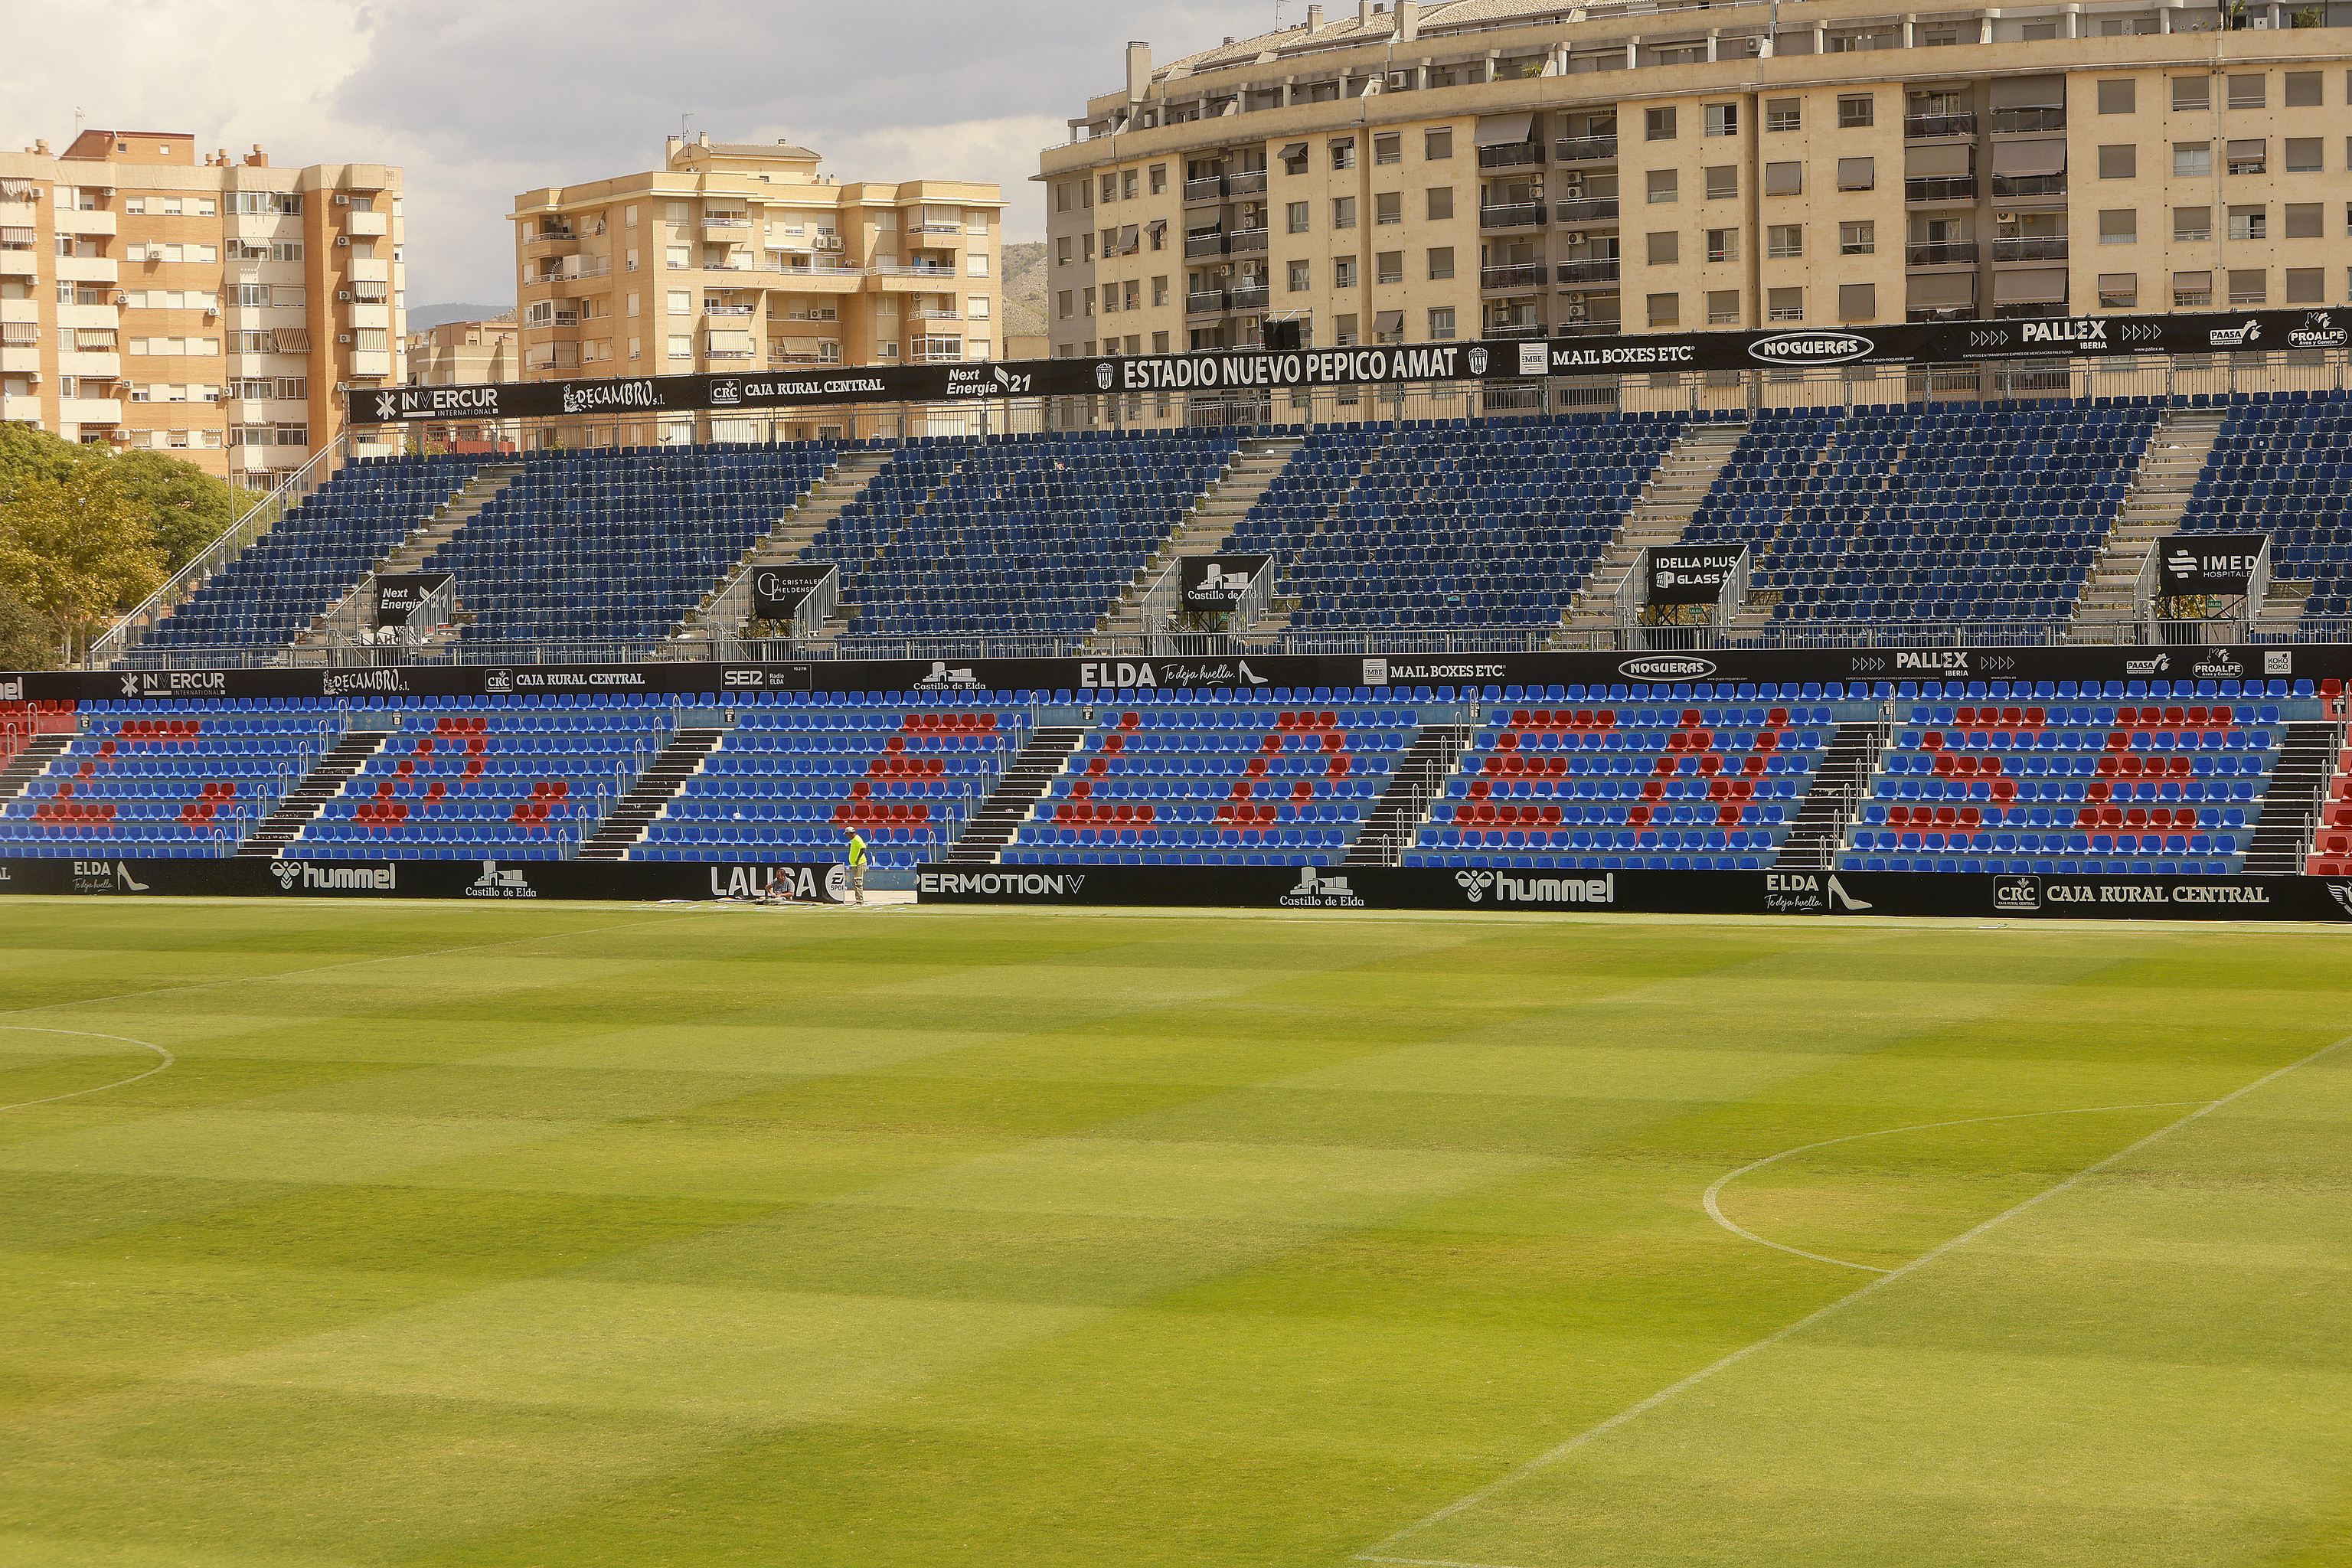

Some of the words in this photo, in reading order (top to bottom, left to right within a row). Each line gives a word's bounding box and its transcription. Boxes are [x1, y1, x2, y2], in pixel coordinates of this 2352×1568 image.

[2023, 321, 2107, 341] PALLEX
[2211, 331, 2242, 339] PAASA
[2290, 331, 2345, 341] PROALPE
[1763, 339, 1859, 356] NOGUERAS
[1553, 350, 1599, 365] MAIL
[1602, 348, 1655, 363] BOXES
[949, 368, 979, 382] Next
[1124, 357, 1217, 388] ESTADIO
[1223, 355, 1300, 384] NUEVO
[1305, 351, 1386, 381] PEPICO
[1392, 348, 1457, 378] AMAT
[745, 384, 775, 396] CAJA
[777, 382, 822, 394] RURAL
[824, 379, 885, 392] CENTRAL
[946, 381, 997, 397] Energía
[1010, 374, 1031, 393] 21
[401, 387, 498, 411] INVERCUR
[577, 380, 653, 404] DECAMBRO
[653, 394, 665, 406] s.l.
[714, 387, 738, 398] CRC
[1657, 557, 1701, 568] IDELLA
[1704, 556, 1736, 567] PLUS
[2203, 555, 2257, 570] IMED
[1677, 574, 1720, 584] GLASS
[383, 588, 408, 597] Next
[1188, 590, 1223, 599] Castillo
[1228, 590, 1238, 599] de
[381, 599, 422, 611] Energía
[1897, 652, 1968, 668] PALLEX
[1081, 663, 1157, 687] ELDA
[1161, 664, 1174, 683] Te
[1175, 665, 1199, 686] deja
[1390, 666, 1428, 678] MAIL
[1430, 665, 1473, 677] BOXES
[1630, 662, 1705, 675] NOGUERAS
[2194, 665, 2242, 673] PROALPE
[143, 673, 225, 688] INVERCUR
[334, 668, 400, 689] DECAMBRO
[399, 680, 410, 691] s.l.
[488, 676, 510, 687] CRC
[517, 675, 545, 685] CAJA
[547, 675, 586, 684] RURAL
[589, 674, 645, 684] CENTRAL
[724, 671, 763, 685] SER
[74, 862, 111, 875] ELDA
[303, 862, 395, 889] hummel
[79, 879, 93, 892] deja
[1497, 871, 1613, 902] hummel
[1767, 875, 1819, 890] ELDA
[466, 887, 500, 897] Castillo
[503, 887, 514, 897] de
[516, 887, 537, 897] Elda
[1998, 887, 2035, 901] CRC
[2047, 886, 2096, 902] CAJA
[2100, 887, 2168, 902] RURAL
[2173, 887, 2269, 902] CENTRAL
[1280, 896, 1321, 905] Castillo
[1325, 897, 1337, 906] de
[1340, 897, 1364, 906] Elda
[1765, 894, 1775, 909] Te
[1775, 895, 1794, 911] deja
